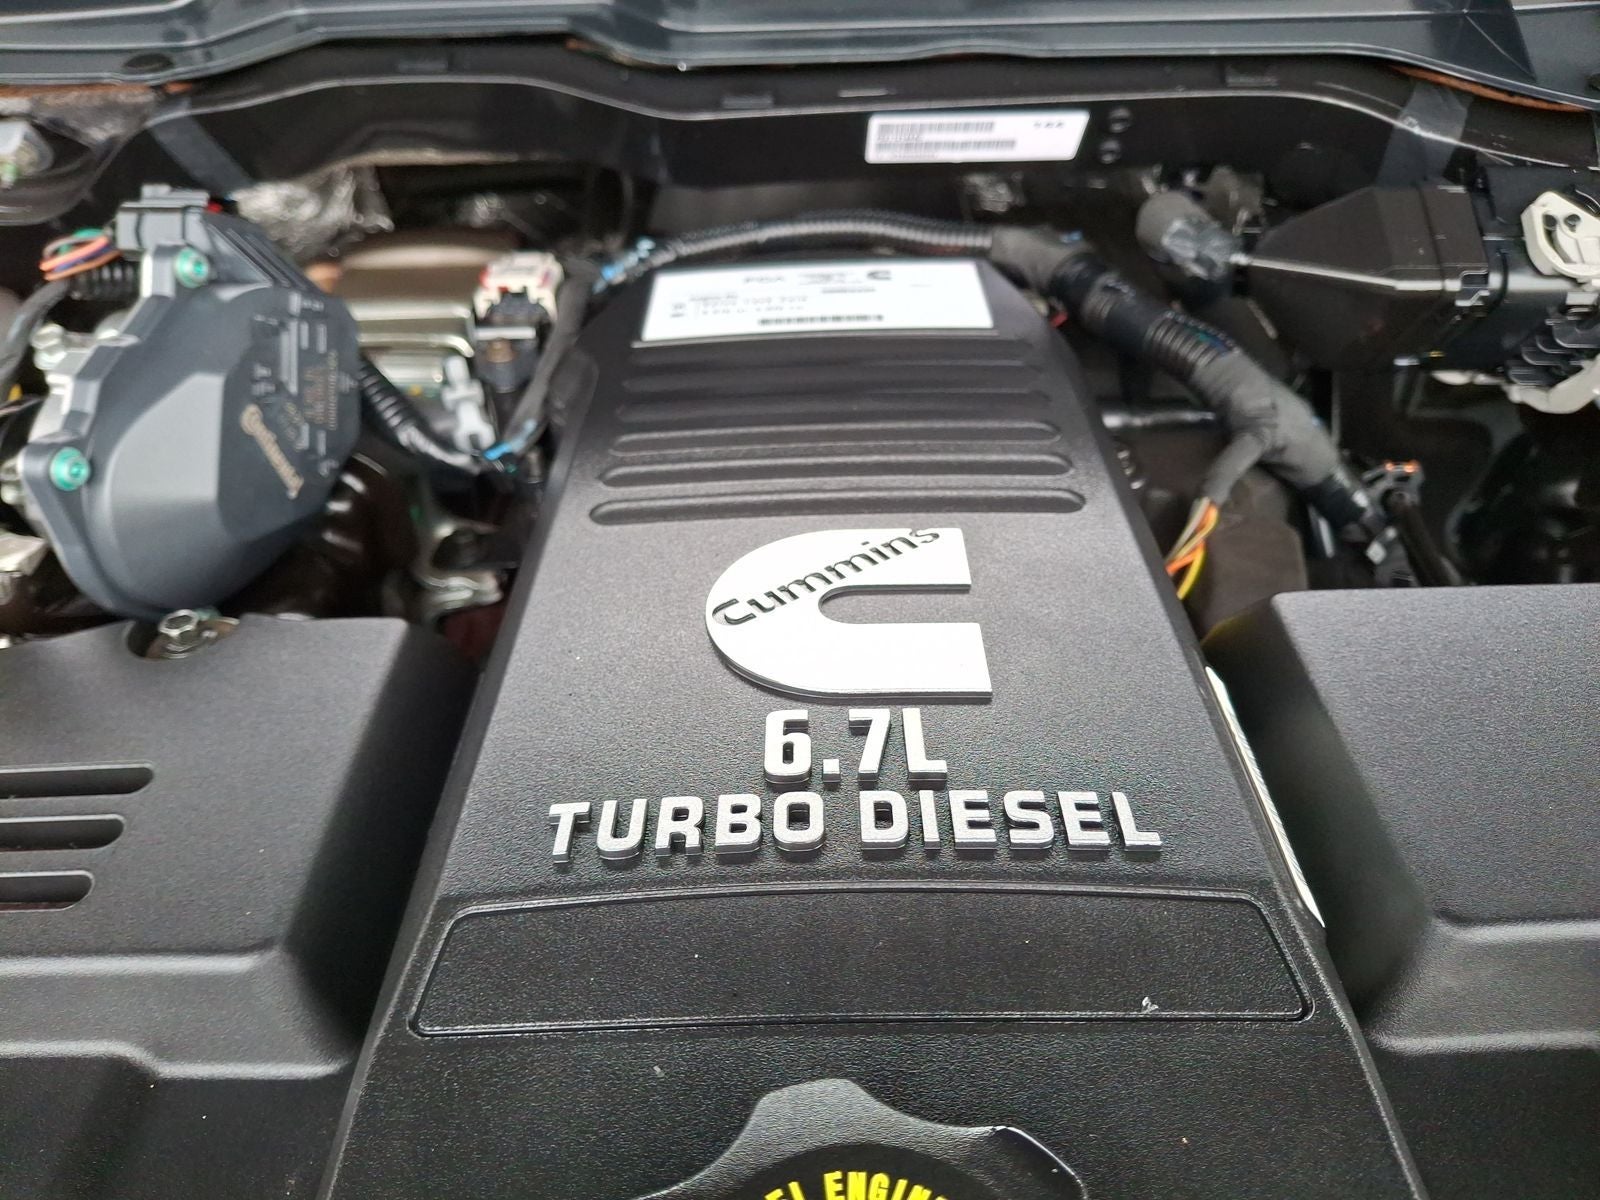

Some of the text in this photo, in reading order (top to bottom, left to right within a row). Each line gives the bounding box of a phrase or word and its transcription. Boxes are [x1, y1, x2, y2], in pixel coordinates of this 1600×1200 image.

[711, 527, 940, 626] Cummins
[765, 708, 947, 782] 6.7L
[549, 790, 1163, 863] TURBO DIESEL
[823, 1170, 949, 1200] ENGI
